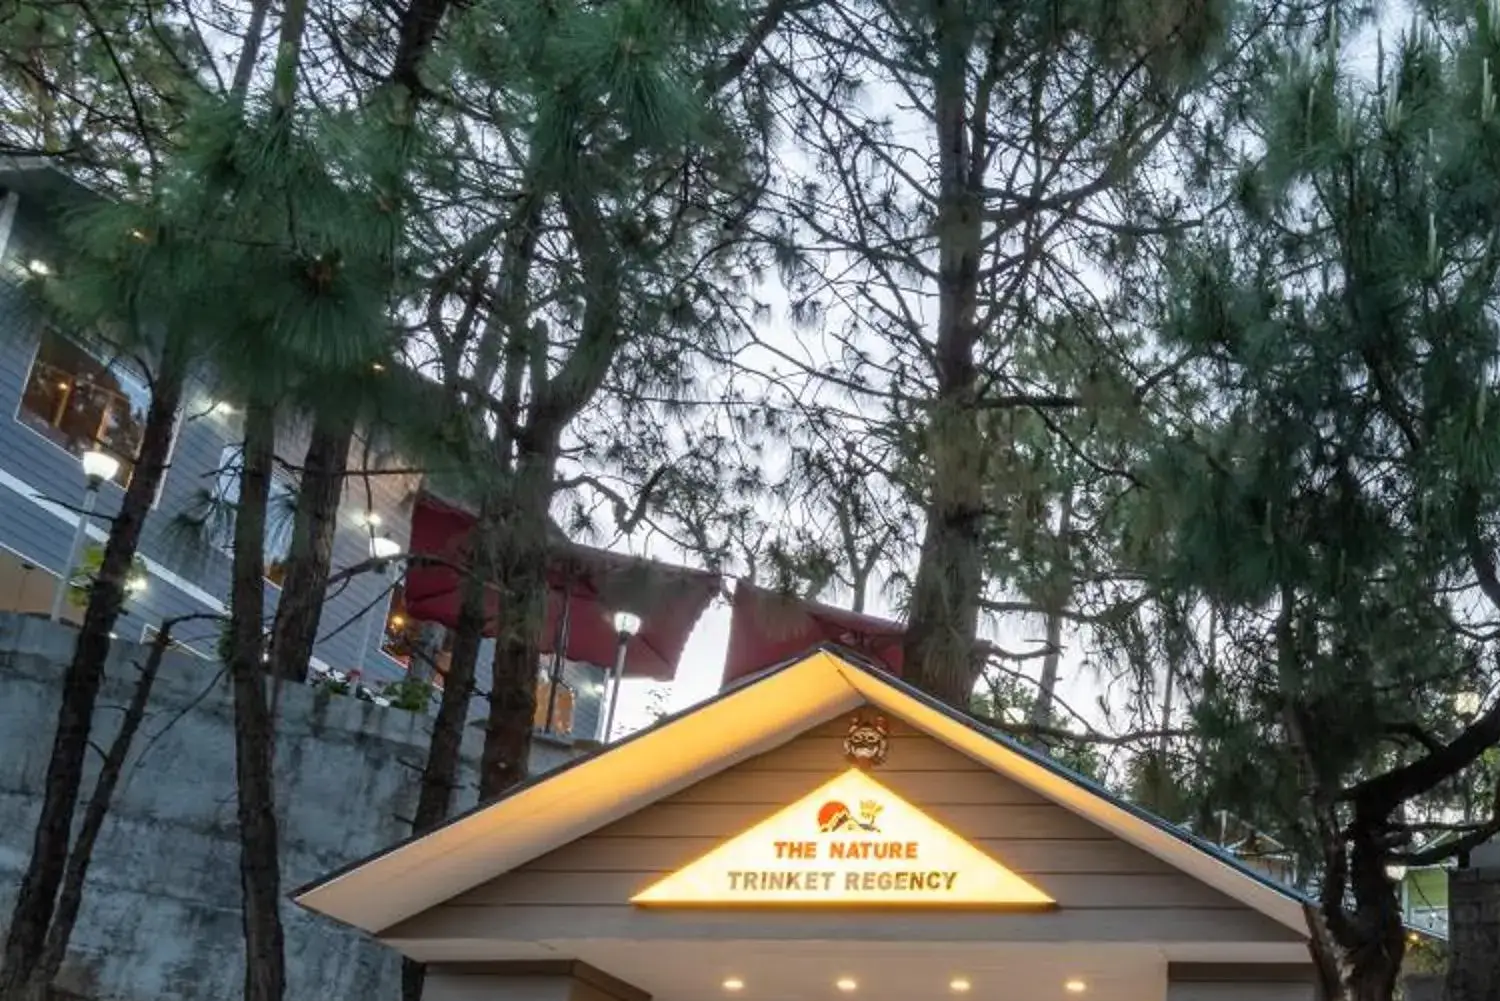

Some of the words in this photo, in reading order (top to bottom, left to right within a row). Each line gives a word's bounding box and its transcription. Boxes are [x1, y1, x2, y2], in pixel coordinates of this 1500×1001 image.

[773, 841, 817, 860] THE
[829, 841, 918, 860] NATURE
[727, 870, 834, 891] TRINKET
[844, 870, 958, 891] REGENCY
